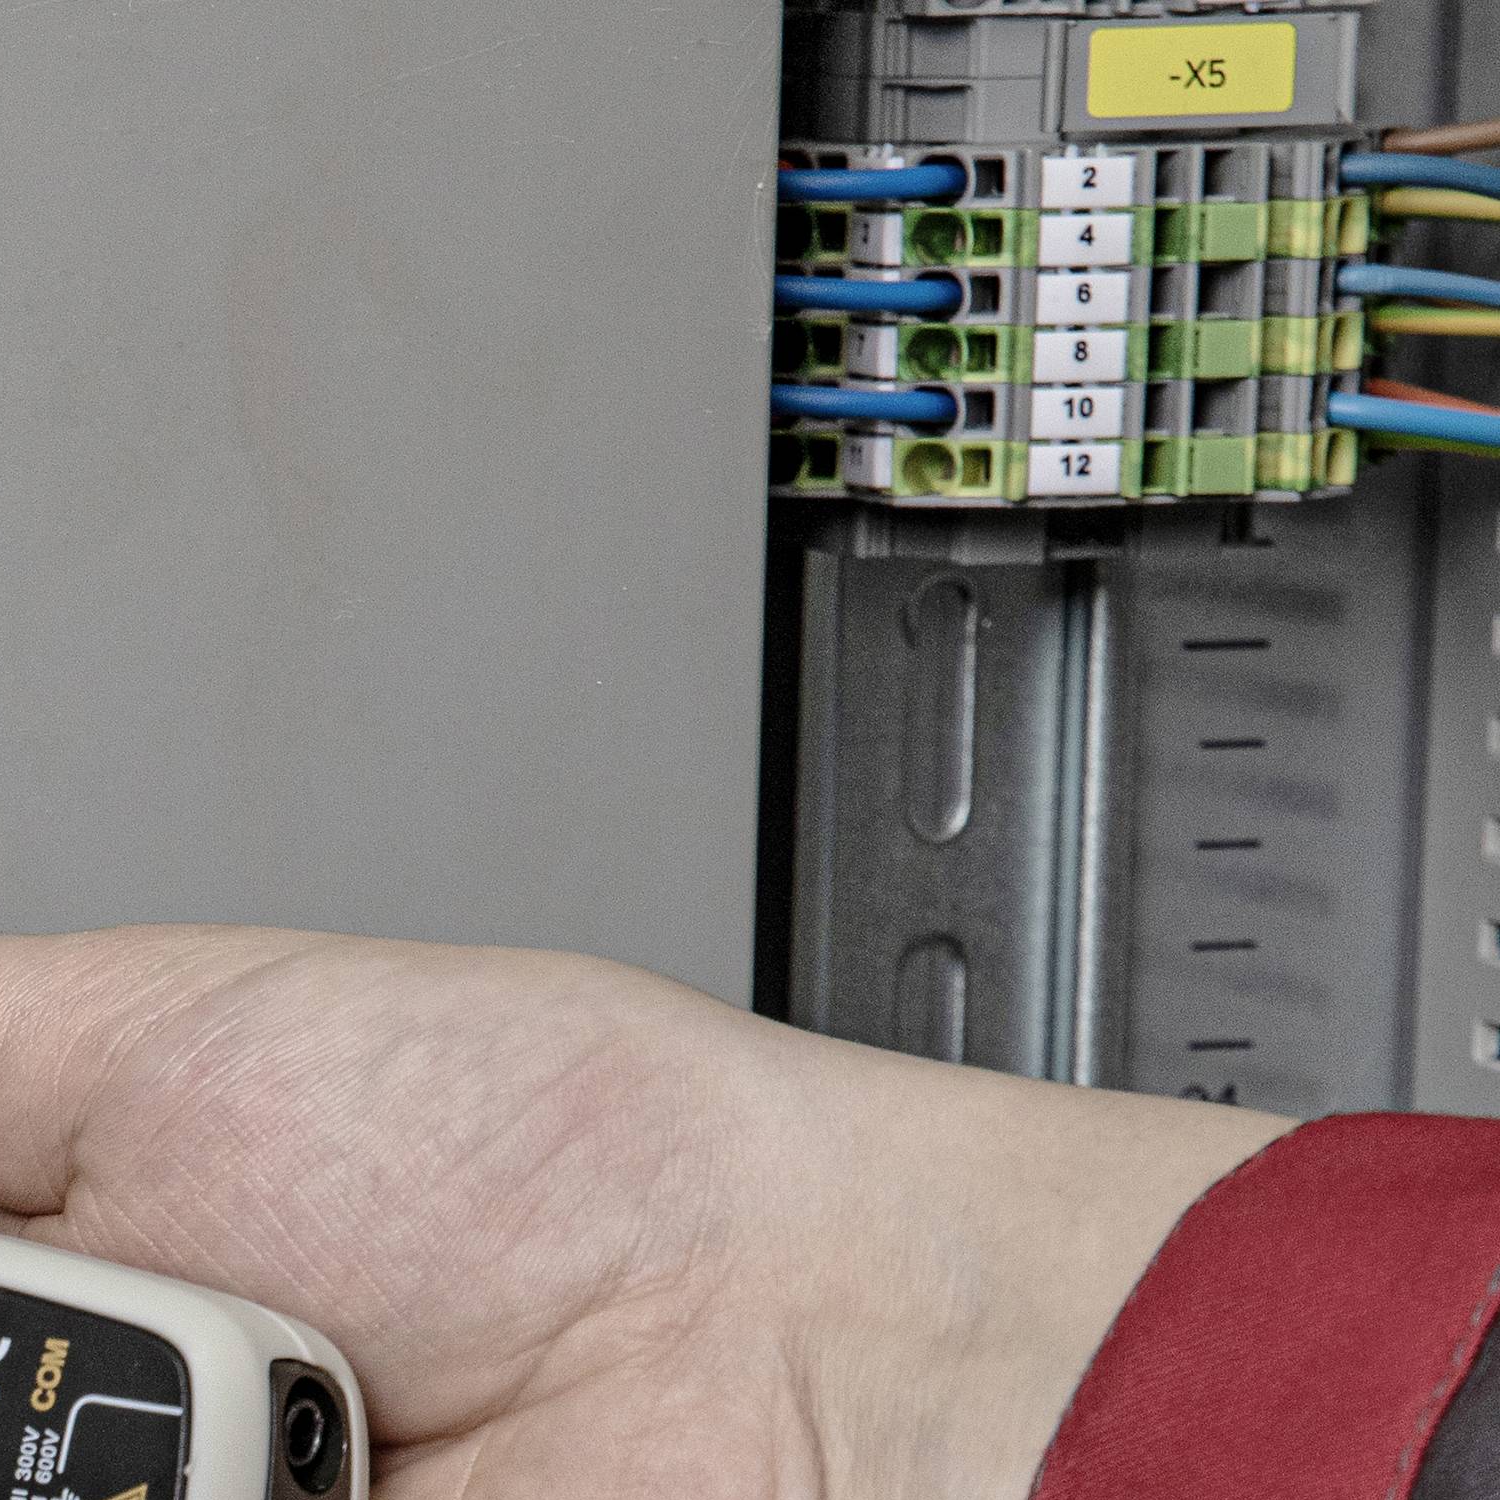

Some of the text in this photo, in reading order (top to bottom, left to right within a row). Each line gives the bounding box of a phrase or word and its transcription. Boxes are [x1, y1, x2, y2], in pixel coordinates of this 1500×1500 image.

[1169, 58, 1226, 89] -X5
[1082, 166, 1097, 189] 2
[1078, 224, 1095, 246] 4
[1076, 282, 1092, 305] 6
[1073, 340, 1089, 363] 8
[1064, 396, 1094, 419] 10
[1061, 453, 1091, 477] 12
[30, 1336, 70, 1412] COM
[14, 1425, 41, 1482] 300V
[34, 1427, 60, 1484] 600V
